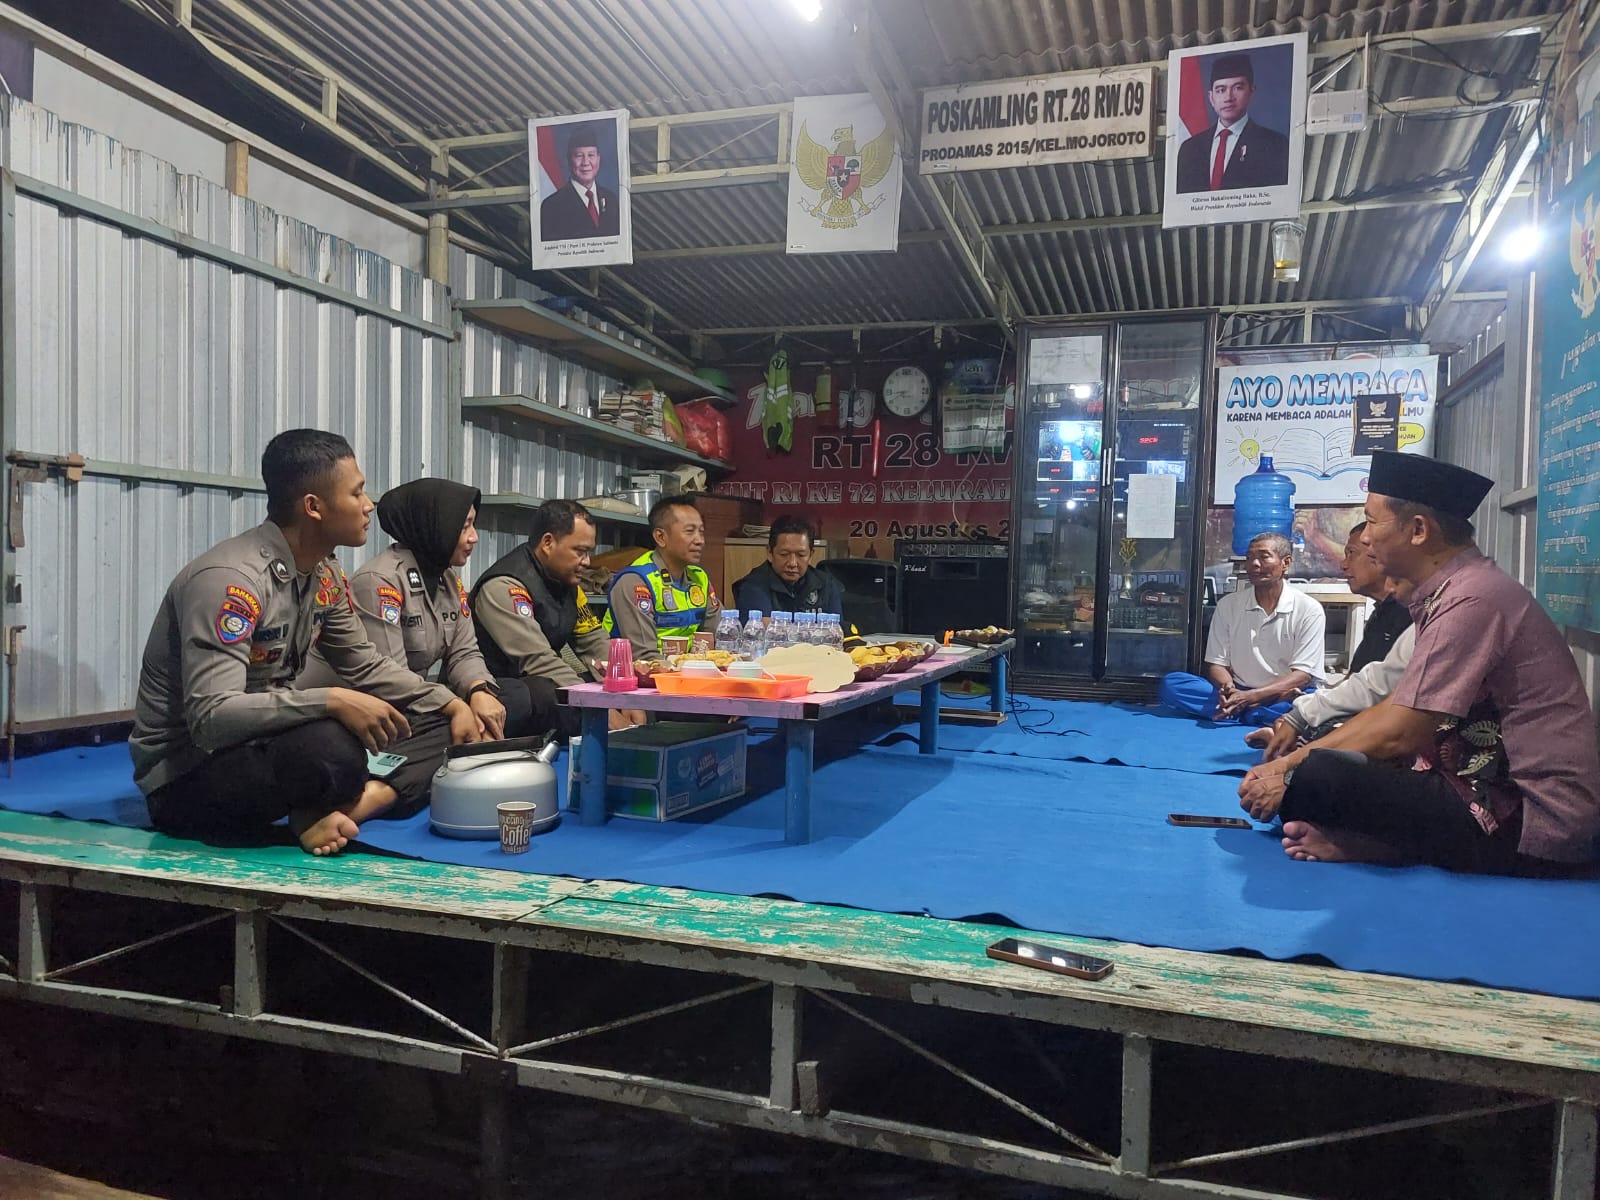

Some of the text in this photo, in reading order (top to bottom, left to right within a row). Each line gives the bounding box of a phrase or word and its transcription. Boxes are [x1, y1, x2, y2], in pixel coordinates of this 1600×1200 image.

[928, 81, 1145, 134] POSKAMLING RT.28 RW.09
[921, 131, 1146, 162] PRODAMAS 2015/KEL.MOJOROTO
[1225, 375, 1283, 409] AYO
[1226, 410, 1262, 422] KARENA
[1265, 410, 1311, 422] MEMBACA
[1314, 410, 1352, 420] ADALAH
[811, 434, 872, 469] RT
[884, 433, 940, 468] 28
[772, 481, 801, 505] RI
[806, 481, 842, 505] KE
[849, 484, 876, 505] 72
[849, 520, 878, 538] 20
[887, 520, 988, 541] Agusts
